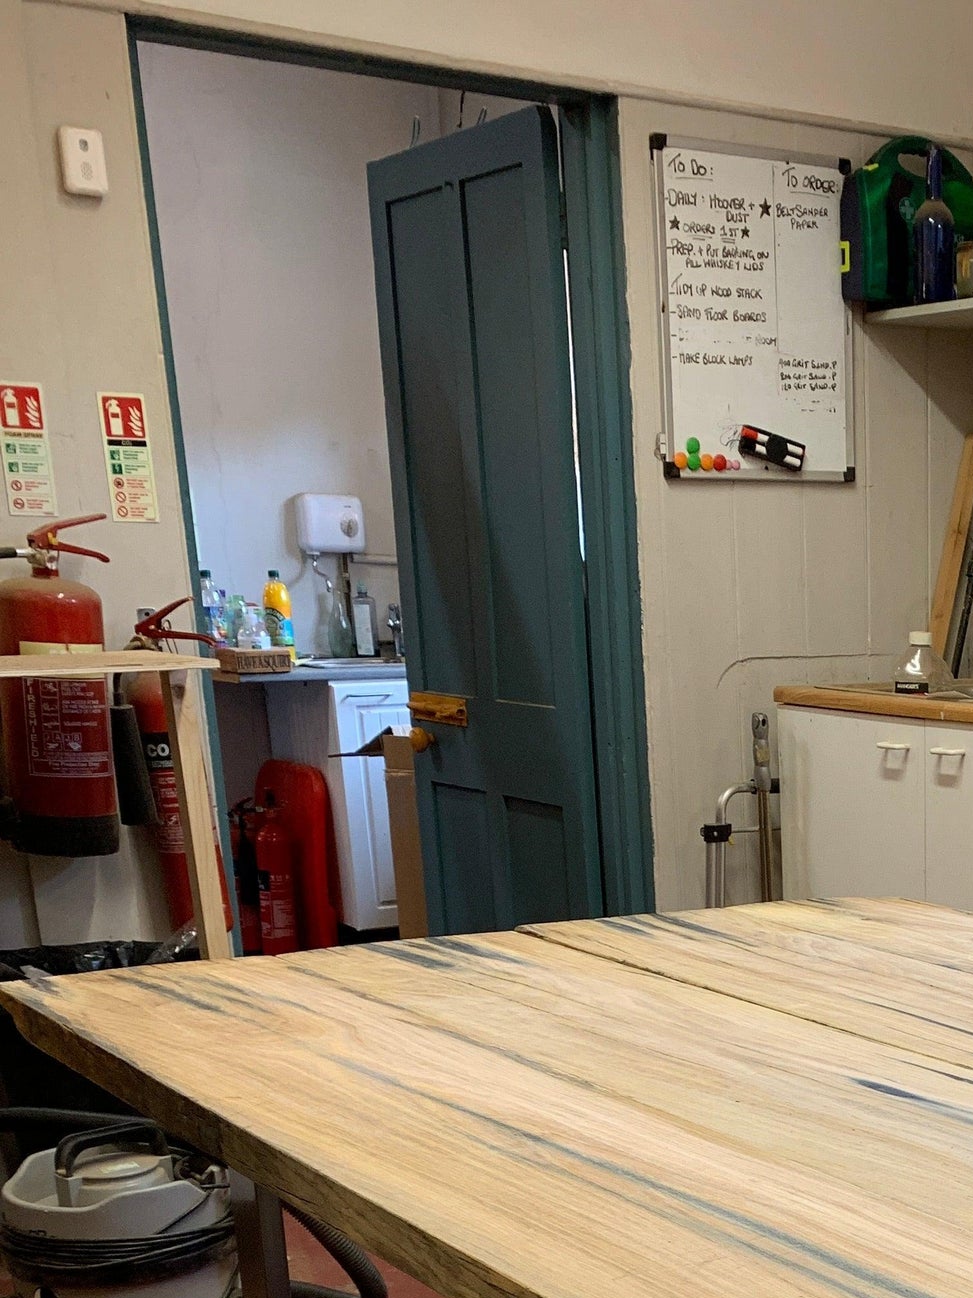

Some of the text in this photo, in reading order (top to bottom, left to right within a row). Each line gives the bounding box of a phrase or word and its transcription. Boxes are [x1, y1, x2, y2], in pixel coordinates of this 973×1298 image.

[668, 153, 685, 173] To
[782, 167, 798, 187] To
[726, 211, 750, 223] DUST
[757, 251, 769, 260] ON
[711, 285, 731, 297] WOOD
[736, 288, 763, 300] STACK
[733, 310, 767, 323] BOARDS
[702, 353, 726, 365] BLOCK
